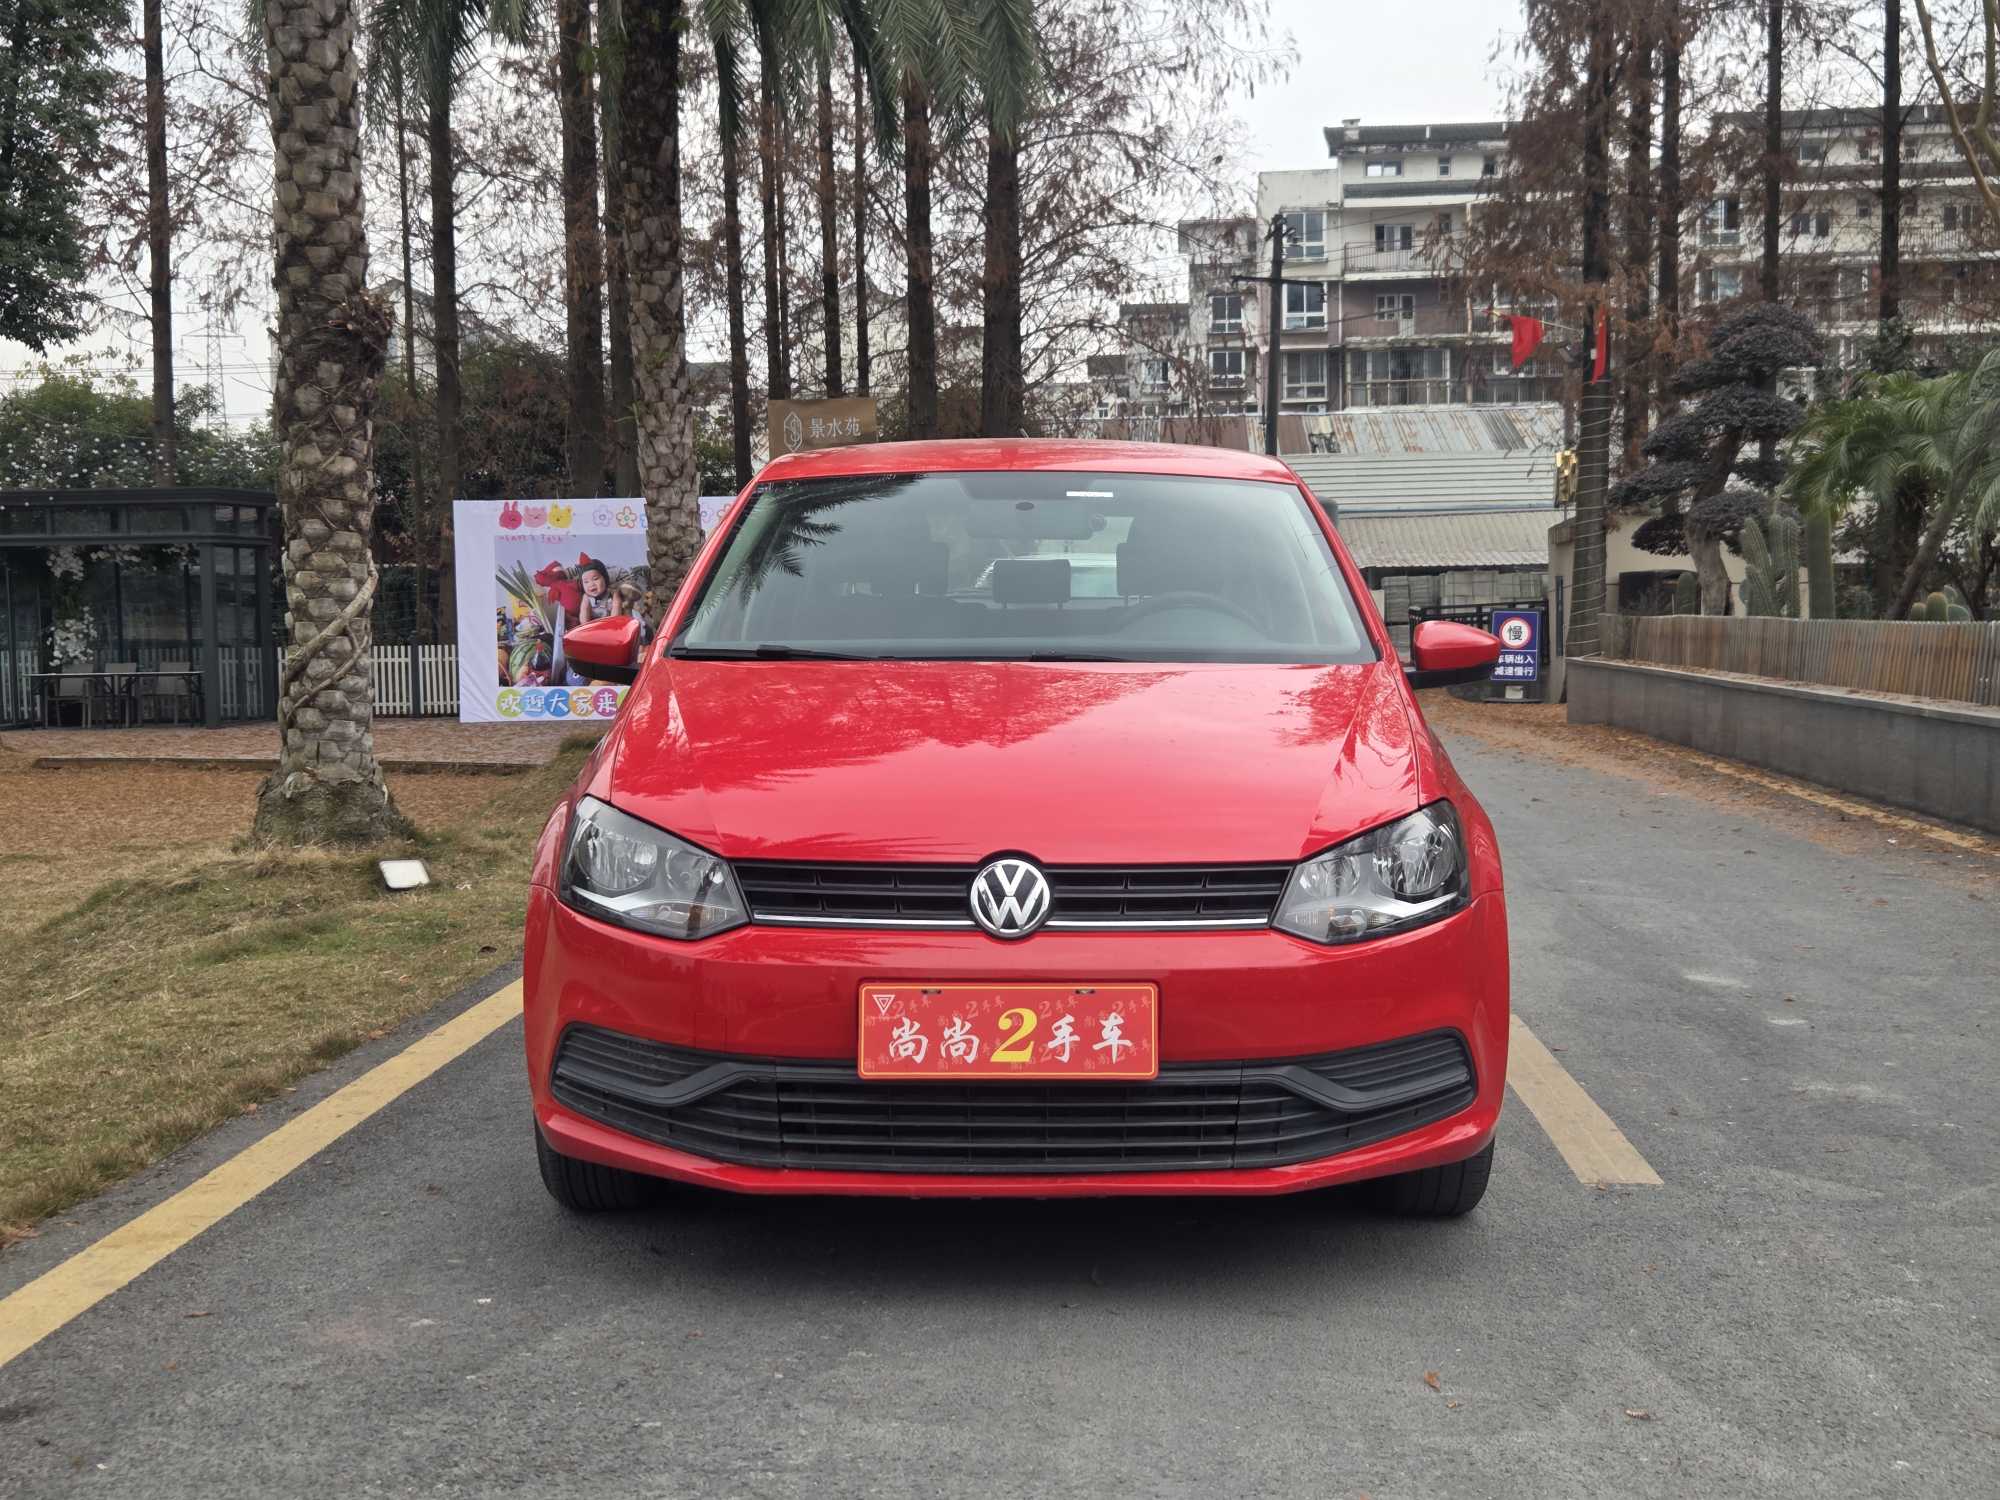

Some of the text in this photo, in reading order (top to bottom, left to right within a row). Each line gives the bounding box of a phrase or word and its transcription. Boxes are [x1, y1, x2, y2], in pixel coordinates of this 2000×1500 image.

[808, 416, 862, 438] 景水苑
[1506, 624, 1523, 641] 慢
[500, 691, 618, 713] 欢迎大家来
[973, 860, 1047, 932] VW
